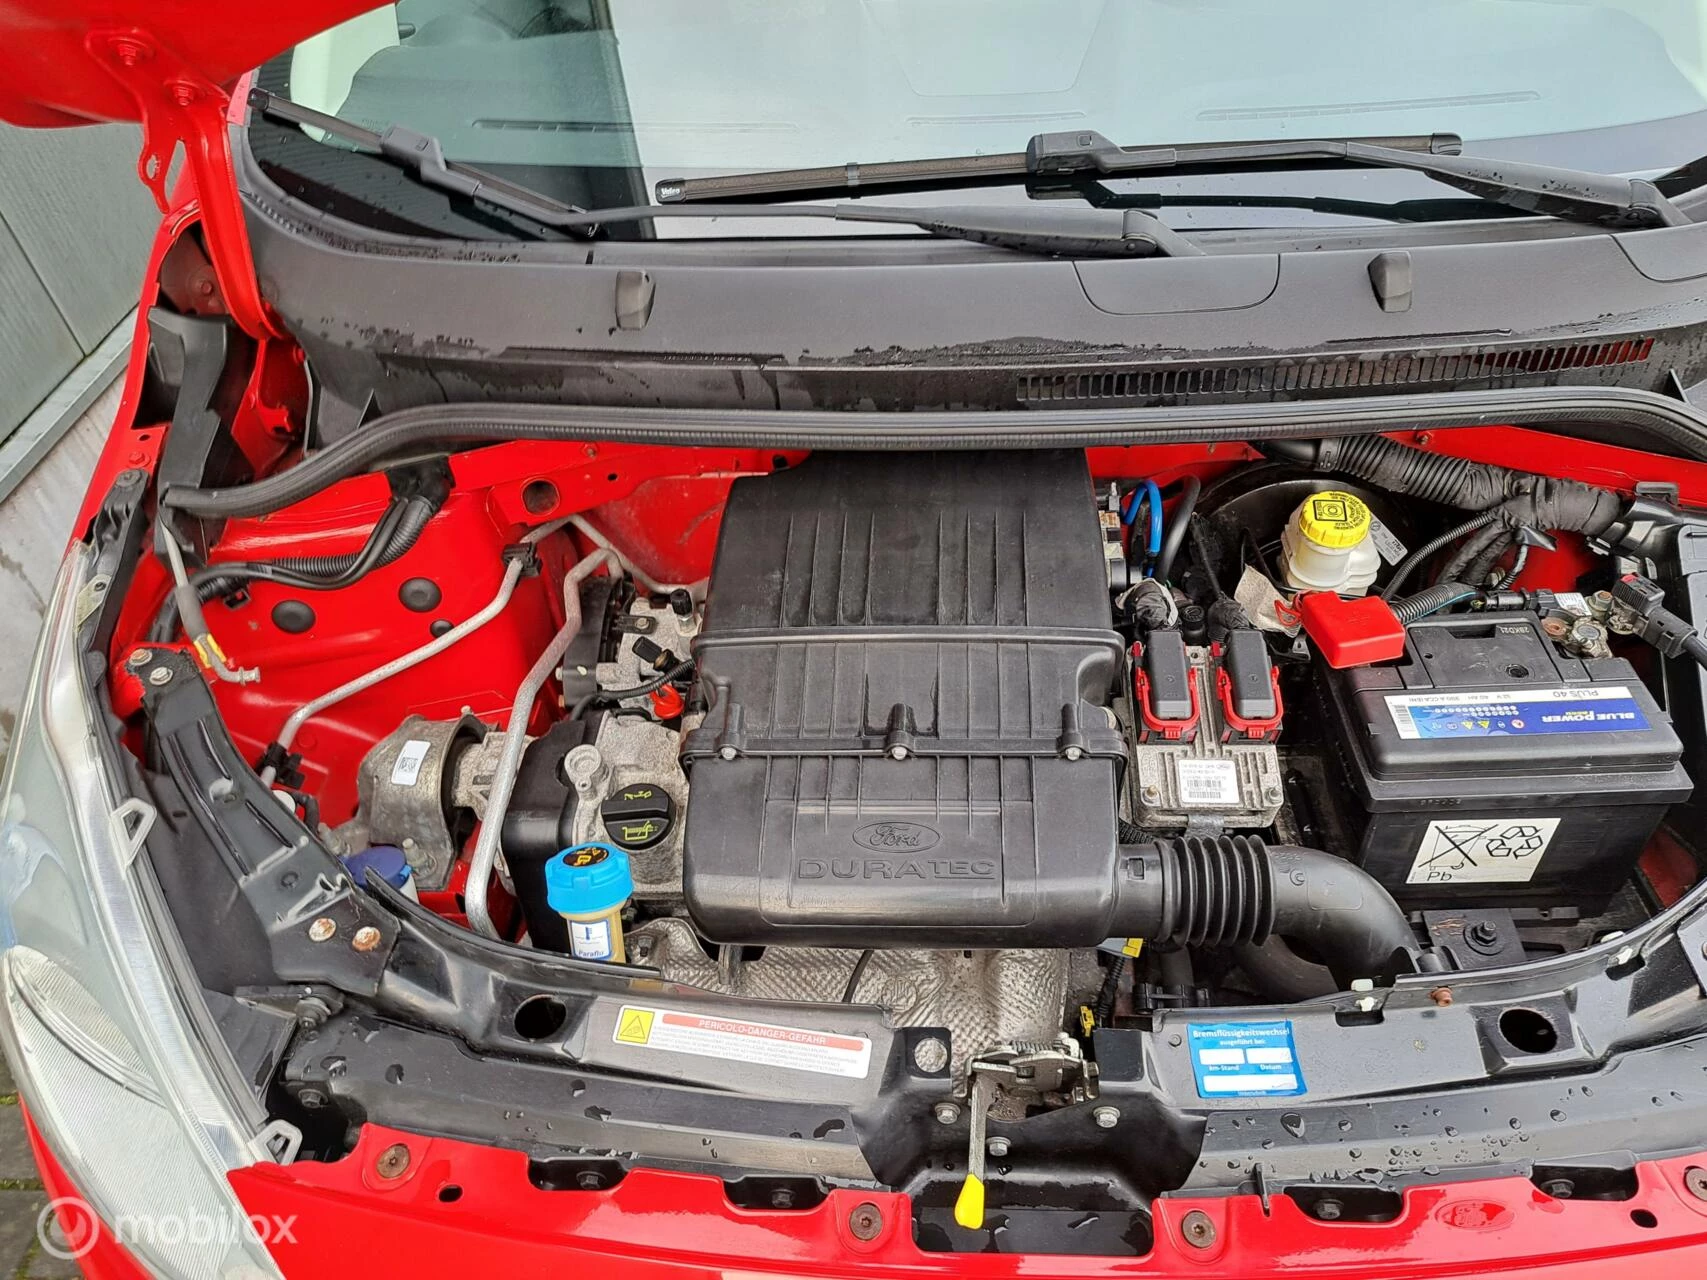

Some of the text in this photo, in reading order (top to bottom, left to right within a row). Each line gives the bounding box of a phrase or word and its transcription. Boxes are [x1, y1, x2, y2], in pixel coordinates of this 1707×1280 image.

[661, 187, 680, 195] Valeo
[1574, 690, 1599, 698] PLUS
[1600, 712, 1635, 722] BLUE
[869, 825, 922, 847] Ford
[798, 858, 995, 880] DURATEC
[1427, 872, 1452, 881] Pb
[698, 1018, 827, 1045] PERICOLO-DANGER-GEFAHR
[1193, 1028, 1290, 1038] Bremsflüssigkeitswechsel
